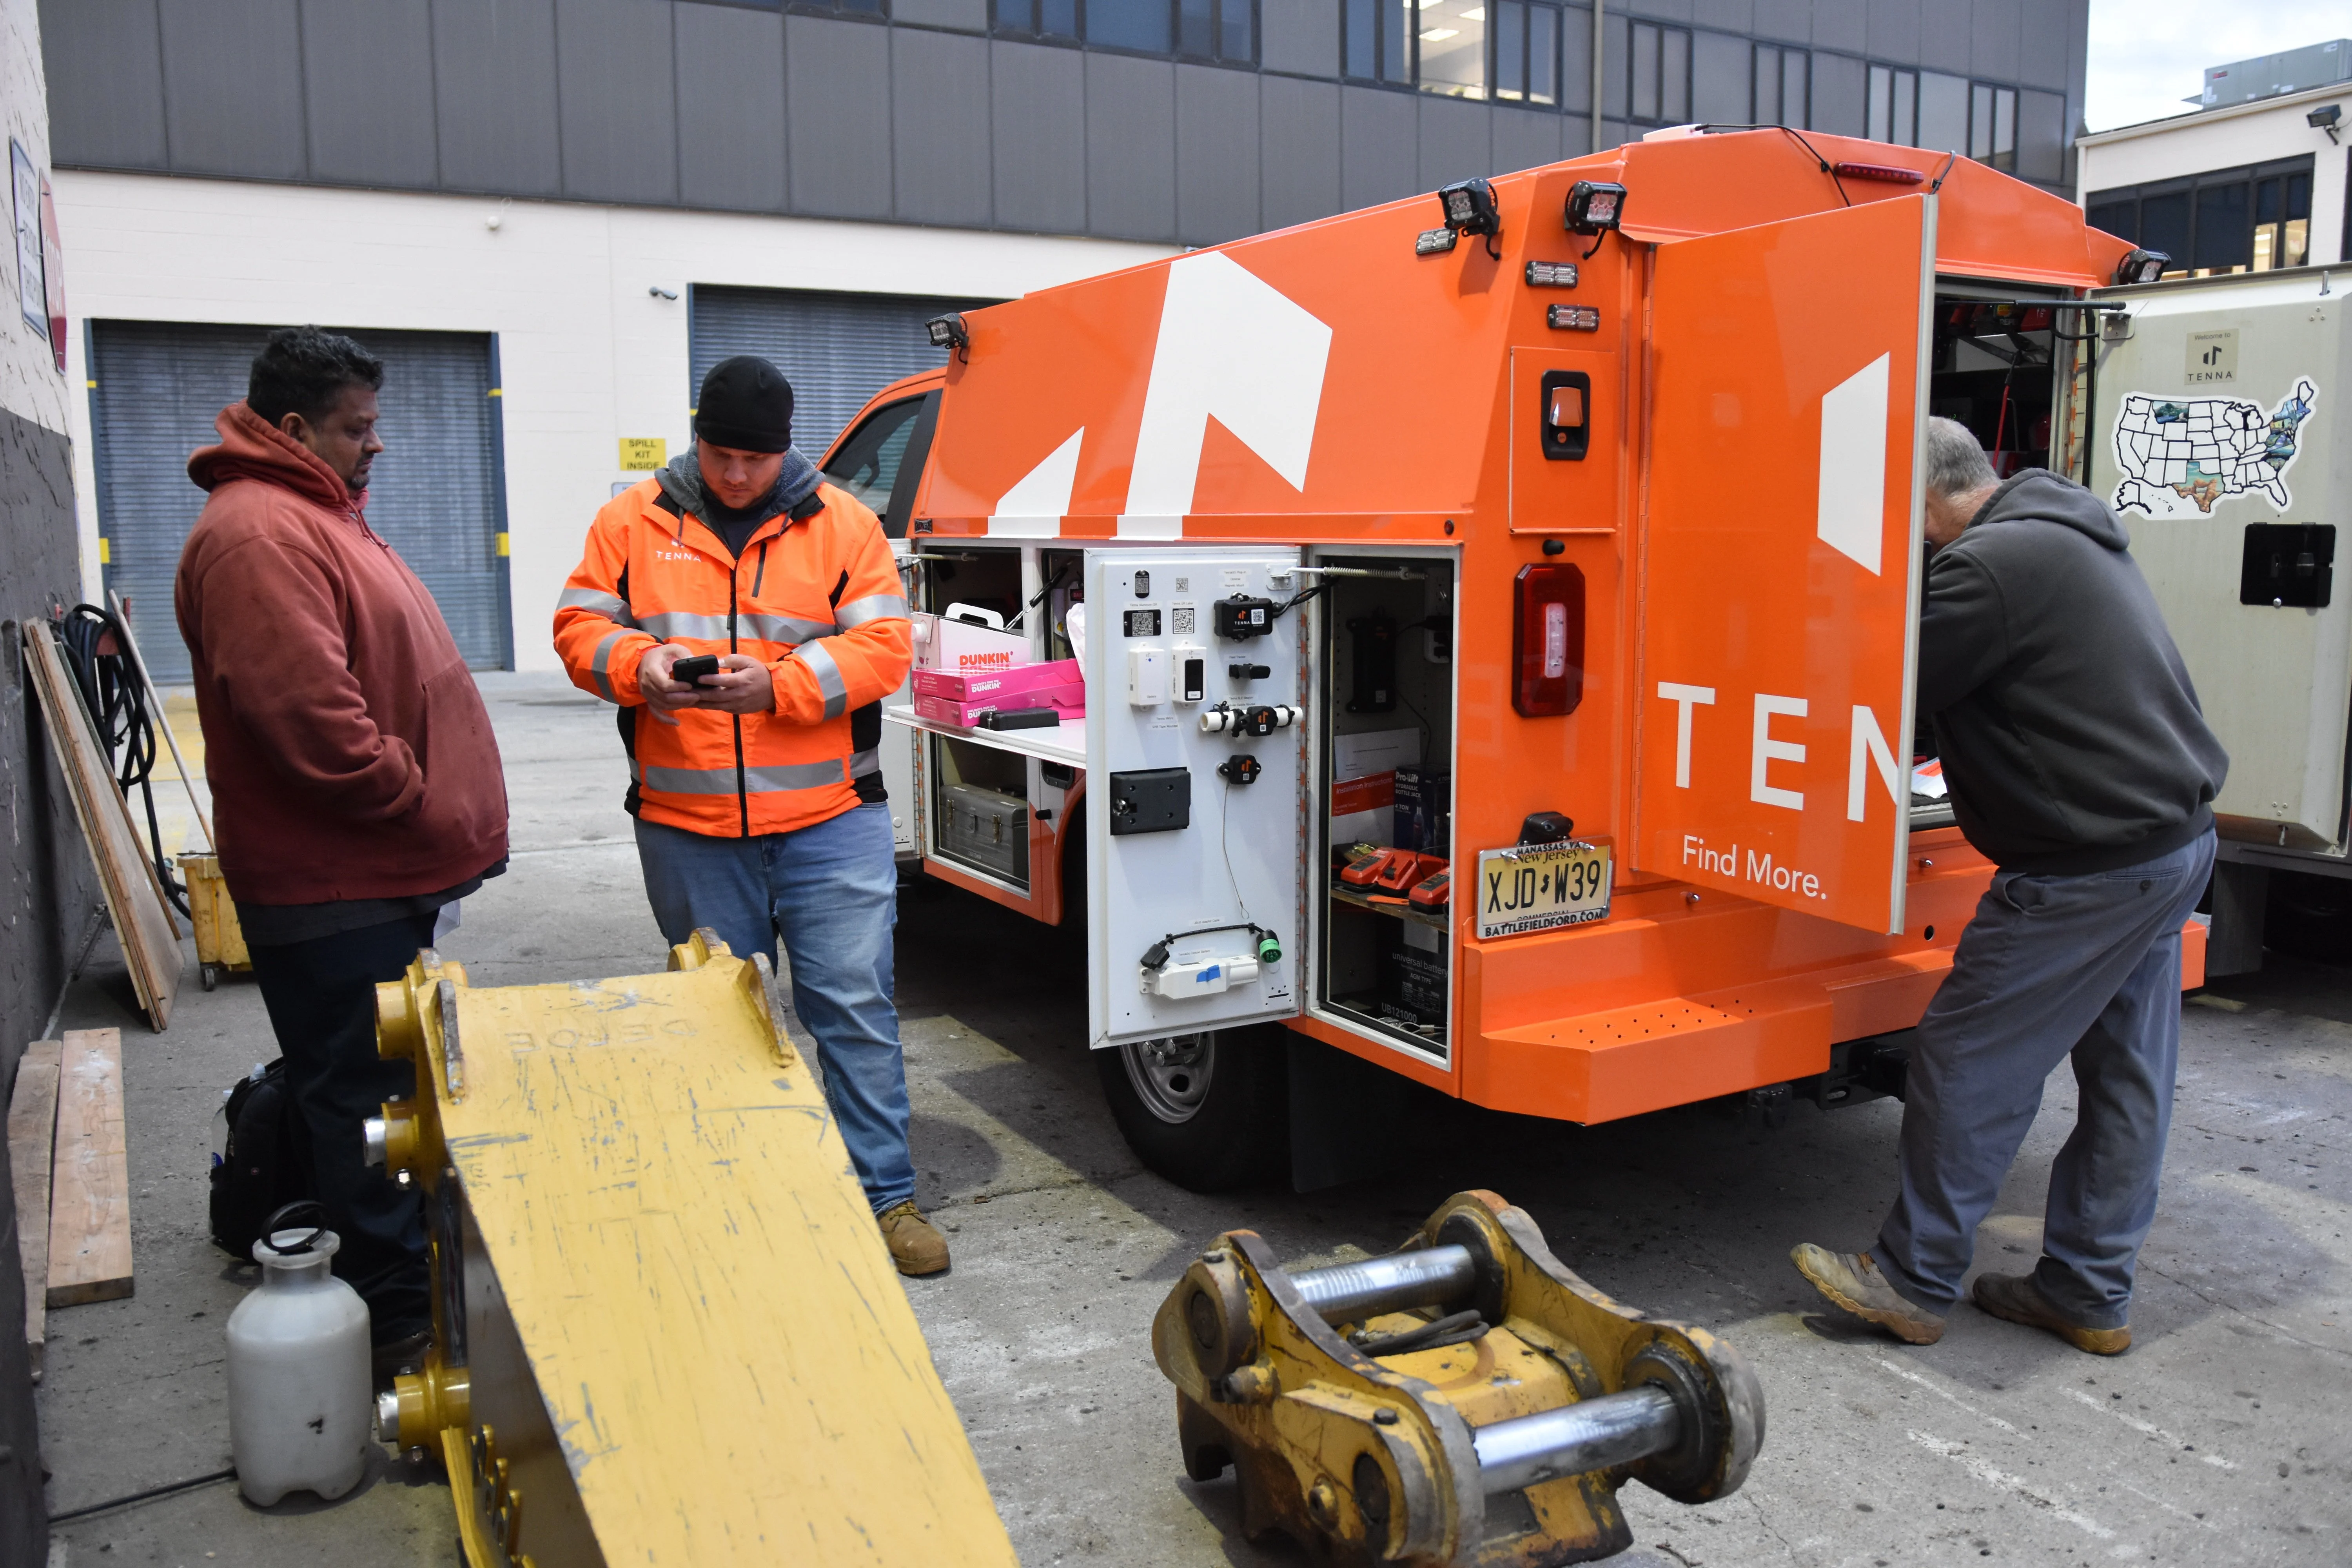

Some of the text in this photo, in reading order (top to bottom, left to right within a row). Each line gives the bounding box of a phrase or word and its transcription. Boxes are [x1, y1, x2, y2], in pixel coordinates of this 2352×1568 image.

[43, 230, 63, 314] STOP
[2187, 371, 2232, 381] TENNA
[628, 439, 656, 448] SPILL
[635, 450, 650, 459] KIT
[627, 461, 660, 470] INSIDE
[656, 550, 701, 562] TENNA
[959, 651, 1013, 666] DUNKIN'
[971, 682, 1001, 693] DUNKIN'
[1336, 777, 1392, 794] Installation Instructions
[1395, 783, 1418, 791] HYDRAULIC
[1516, 842, 1567, 855] MANASSAS,
[1513, 849, 1580, 865] New Jersey
[1683, 835, 1827, 900] Find More.
[1487, 860, 1601, 913] XJD W39
[1485, 910, 1603, 937] BATTLEFIELDFORD.COM
[1392, 952, 1448, 978] universal battery
[1421, 976, 1431, 985] TYPE
[1382, 1002, 1417, 1024] UB121000
